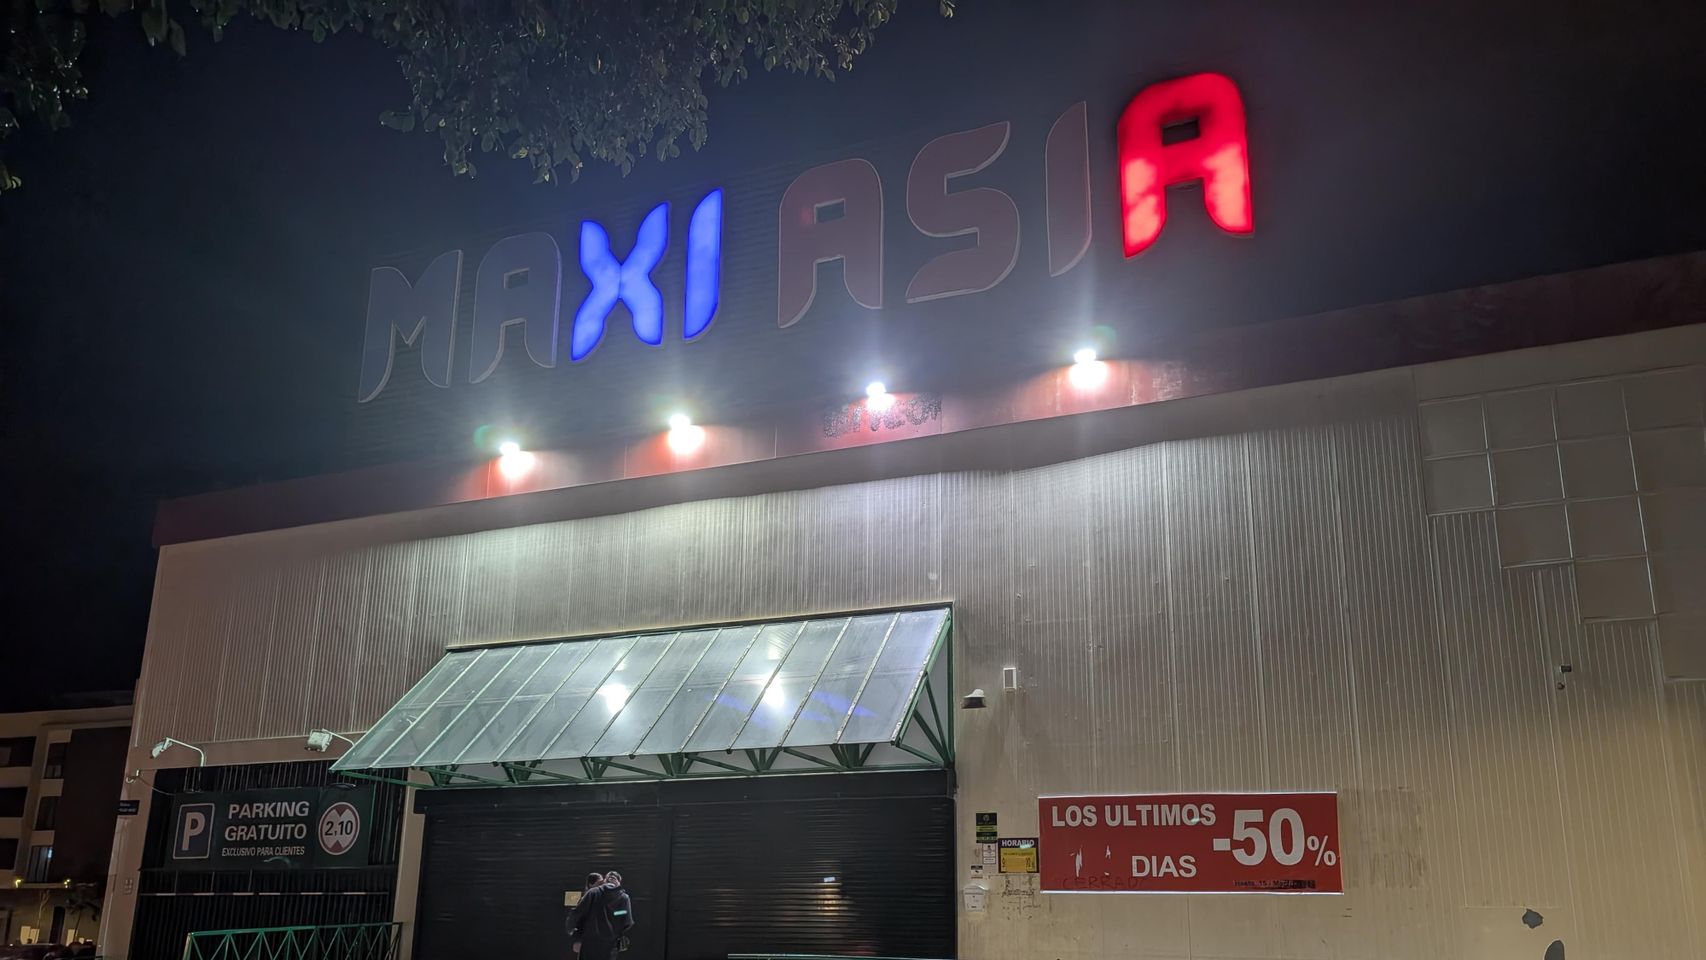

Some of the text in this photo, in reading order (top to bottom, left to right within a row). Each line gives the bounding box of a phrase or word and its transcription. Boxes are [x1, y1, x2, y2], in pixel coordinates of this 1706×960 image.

[358, 70, 1255, 404] MAXI ASIA
[228, 801, 310, 820] PARKING
[1052, 803, 1217, 827] LOS ULTIMOS
[181, 811, 206, 851] P
[224, 823, 307, 841] GRATUITO
[324, 820, 353, 837] 2,10
[1213, 807, 1337, 867] -50%
[221, 846, 305, 857] EXCLUSIVO PARA CLIENTES
[1001, 839, 1035, 848] HORARIO
[1131, 855, 1198, 878] DIAS
